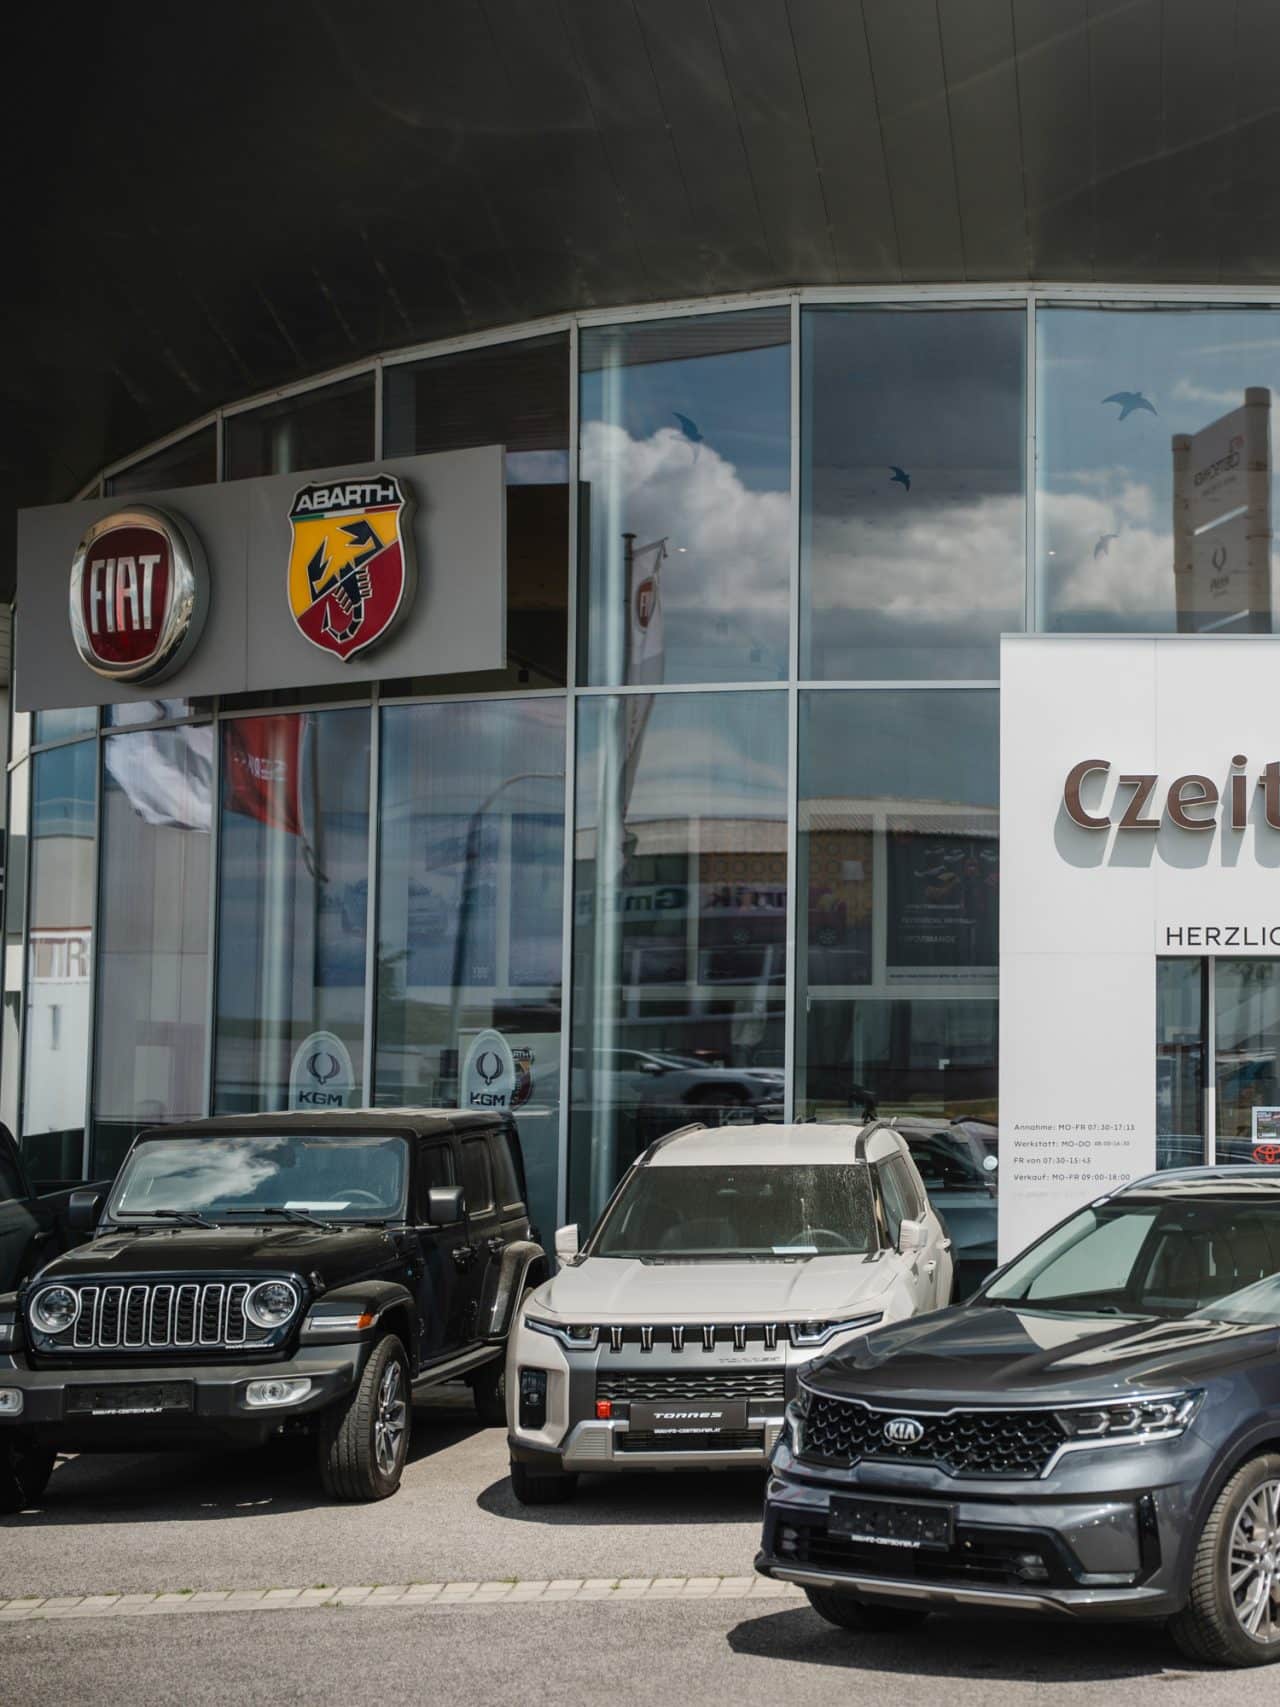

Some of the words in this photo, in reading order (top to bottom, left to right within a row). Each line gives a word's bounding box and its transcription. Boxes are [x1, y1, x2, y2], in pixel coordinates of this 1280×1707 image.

[295, 484, 395, 512] ABARTH
[90, 554, 161, 634] FIAT
[299, 1091, 343, 1106] KGM
[470, 1092, 505, 1106] KGM
[888, 1423, 916, 1440] KIA
